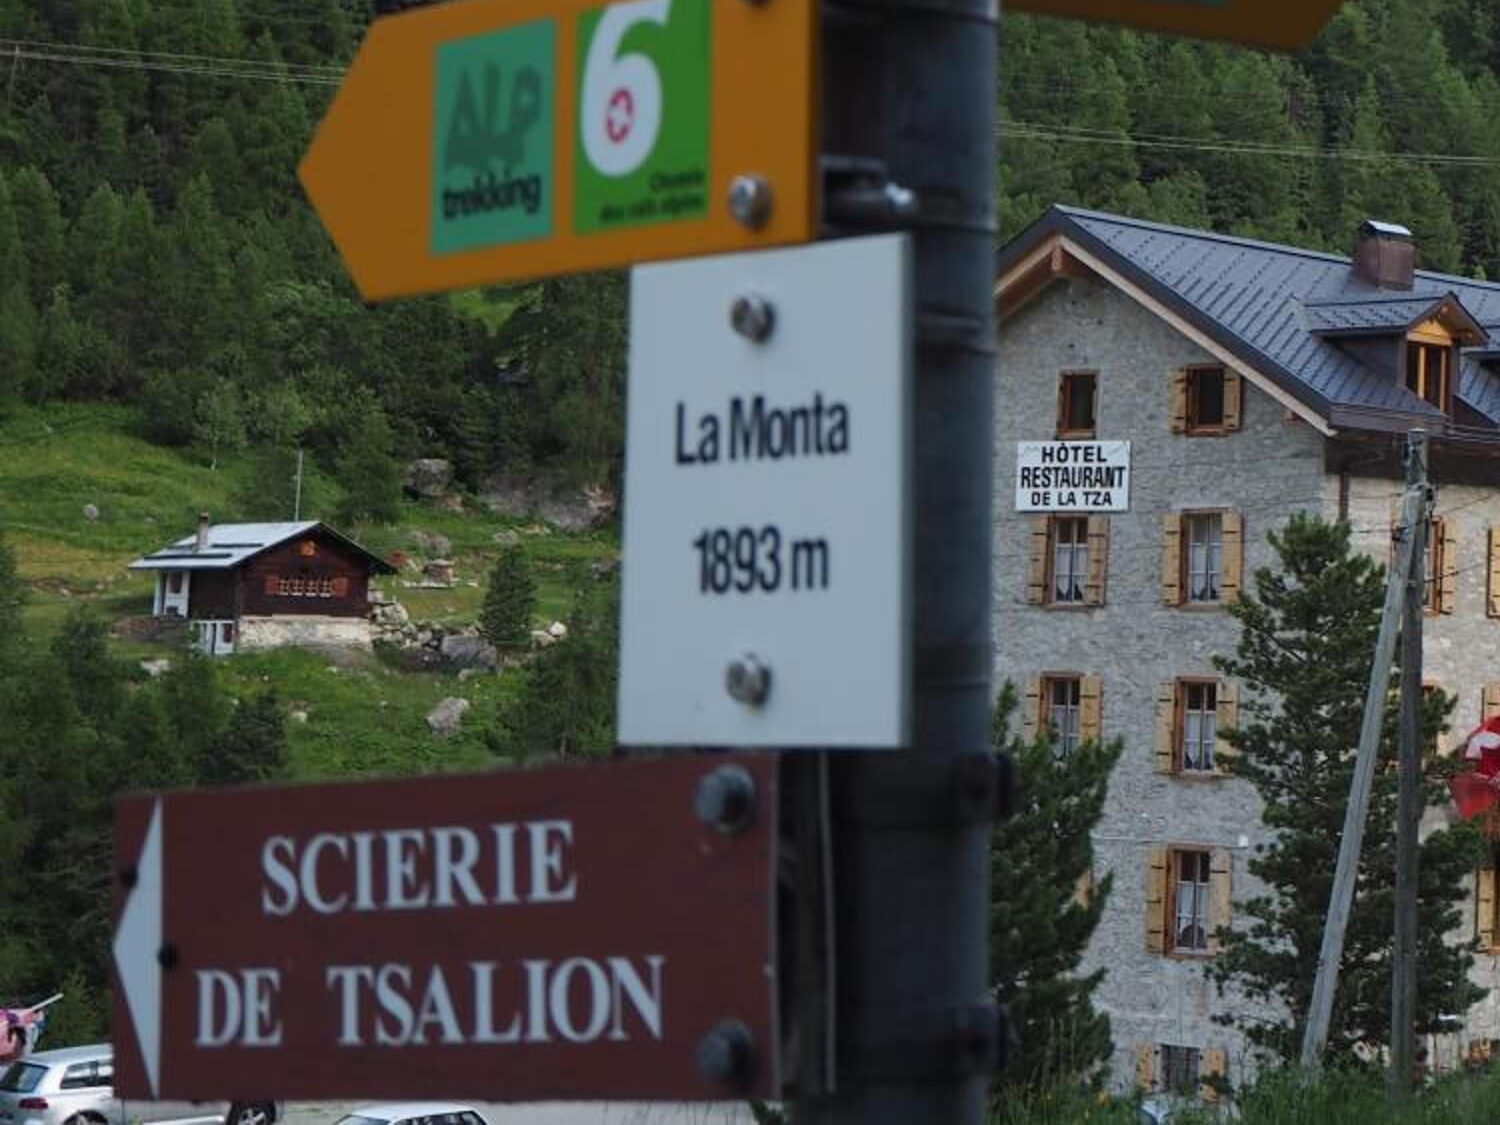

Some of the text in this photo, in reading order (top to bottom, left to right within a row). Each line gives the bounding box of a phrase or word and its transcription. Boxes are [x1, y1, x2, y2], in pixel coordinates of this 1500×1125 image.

[442, 171, 542, 221] trekking
[674, 391, 850, 466] La Monta
[1042, 443, 1107, 463] HÔTEL
[1021, 466, 1126, 489] RESTAURANT
[1031, 491, 1112, 506] DE LA TZA
[693, 526, 829, 595] 1893 m
[261, 819, 578, 916] SCIERIE
[194, 955, 667, 1048] DE TSALION
